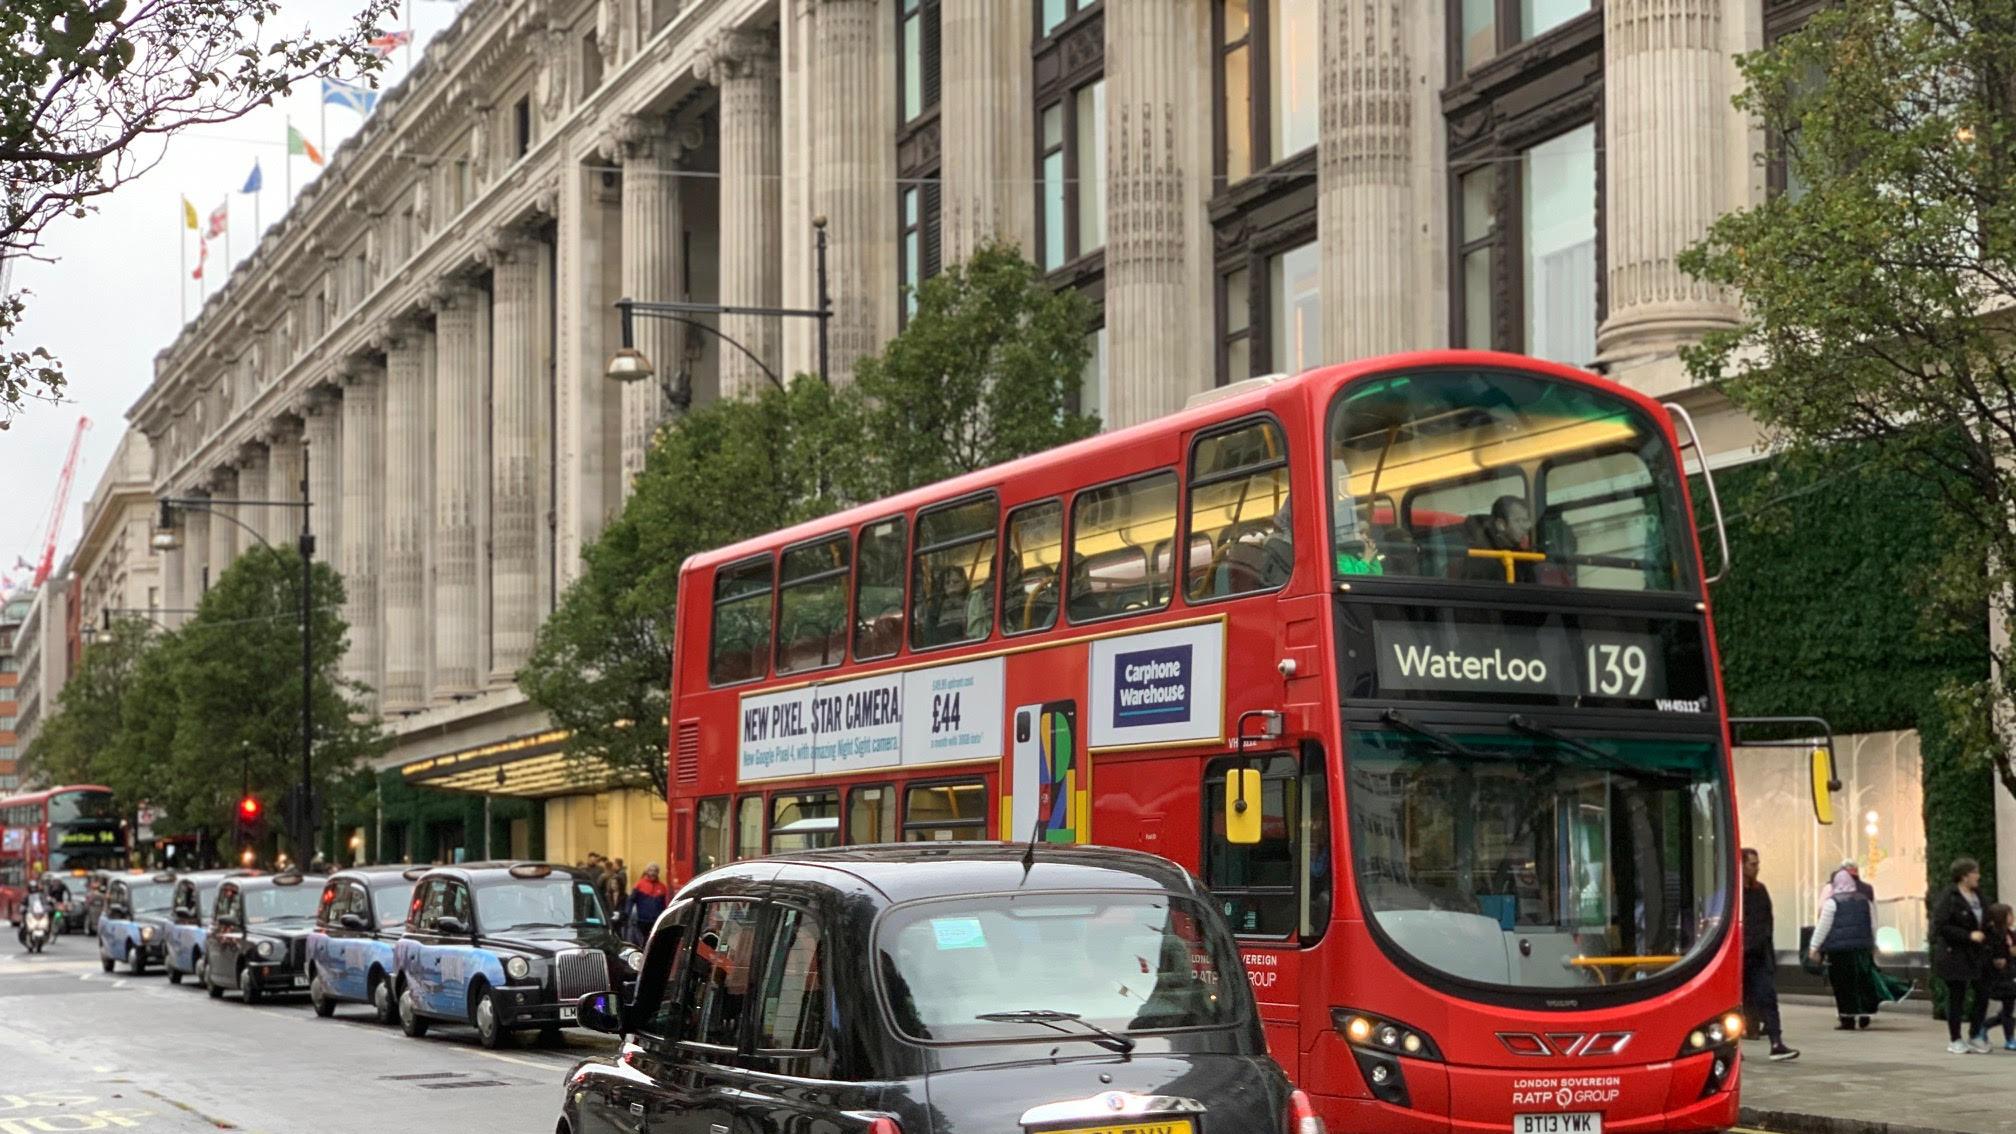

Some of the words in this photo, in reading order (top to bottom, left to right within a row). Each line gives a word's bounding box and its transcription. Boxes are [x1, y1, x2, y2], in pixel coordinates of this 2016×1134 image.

[1125, 660, 1180, 684] Carphone
[1394, 644, 1547, 683] Waterloo
[1587, 644, 1648, 696] 139
[1120, 684, 1185, 706] Warehouse
[744, 706, 770, 742] NEW
[772, 700, 807, 739] PIXEL.
[811, 696, 842, 734] STAR
[846, 685, 902, 730] CAMERA.
[931, 691, 961, 734] £44
[755, 748, 775, 767] Google
[776, 745, 789, 763] Pixel
[797, 743, 809, 760] with
[811, 743, 836, 761] amazing
[838, 738, 853, 759] Night
[855, 736, 871, 758] Sight
[1247, 971, 1278, 987] ROUP
[563, 1007, 577, 1018] LM
[1514, 1079, 1557, 1088] LONDON
[1560, 1077, 1620, 1087] SOVEREIGN
[1513, 1091, 1552, 1104] RATP
[1574, 1089, 1620, 1103] GROUP
[1524, 1115, 1558, 1133] BT13
[1561, 1114, 1592, 1132] YWK
